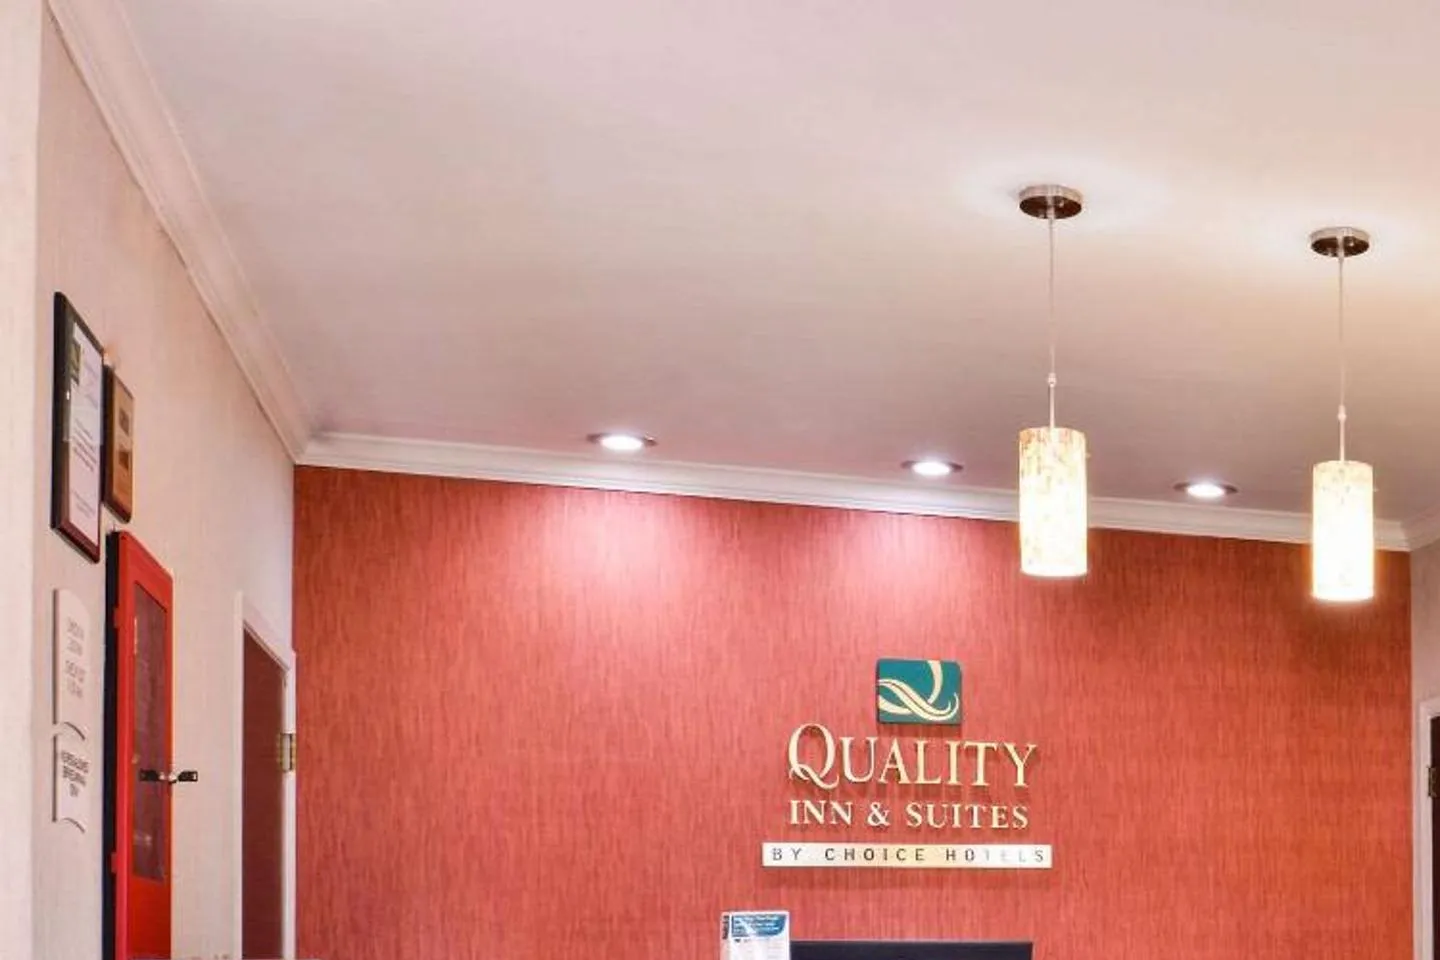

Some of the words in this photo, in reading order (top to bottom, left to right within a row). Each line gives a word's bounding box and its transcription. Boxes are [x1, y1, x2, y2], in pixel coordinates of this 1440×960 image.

[788, 722, 1037, 790] QUALITY
[789, 799, 852, 825] INN
[867, 801, 891, 827] &
[905, 803, 1029, 829] SUITES
[771, 847, 803, 861] BY
[824, 848, 926, 861] CHOICE
